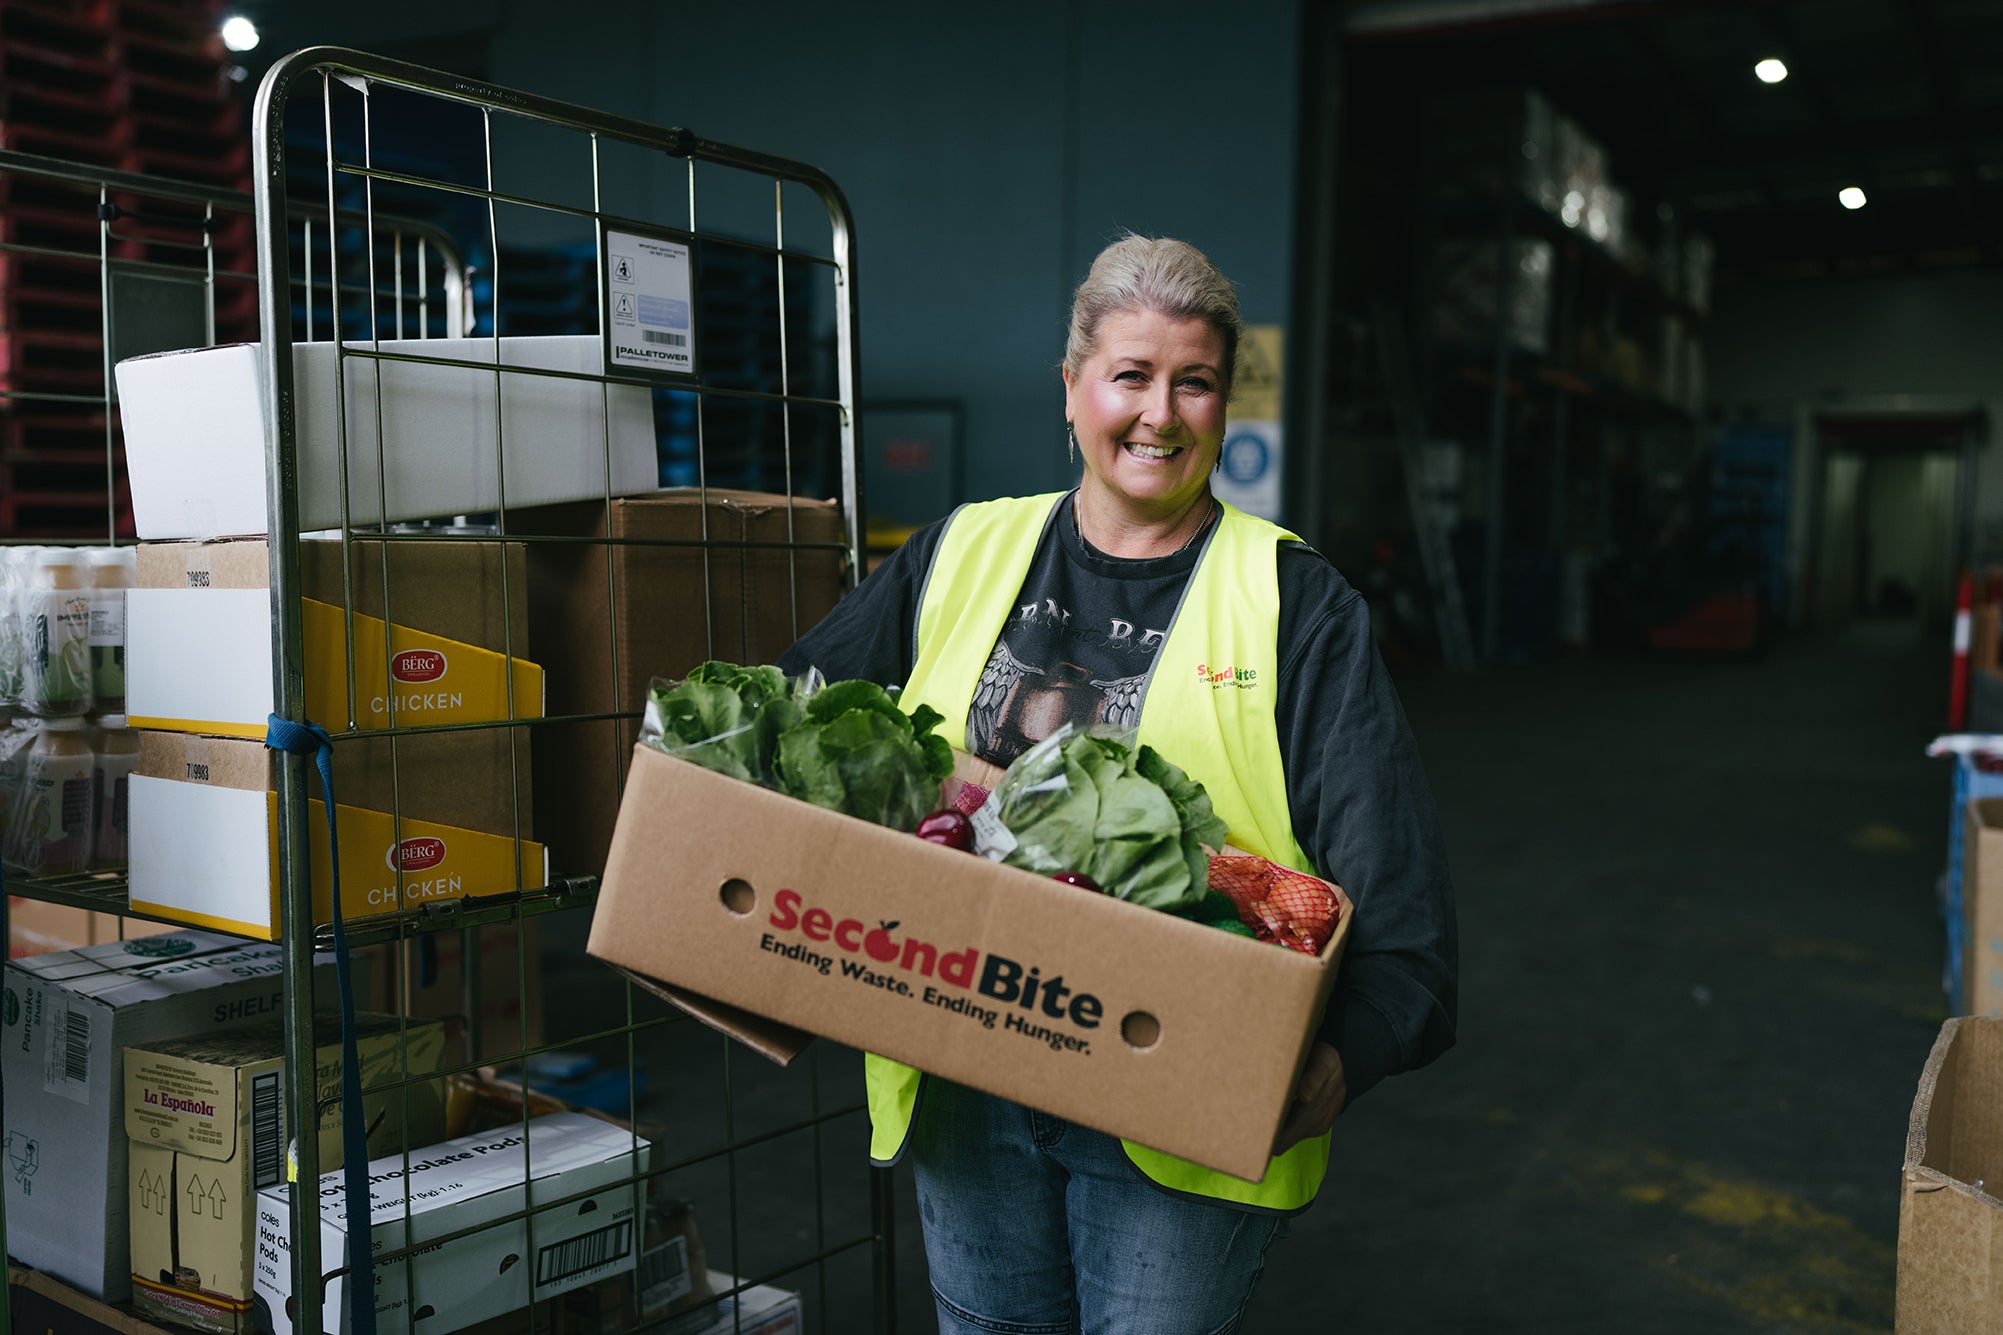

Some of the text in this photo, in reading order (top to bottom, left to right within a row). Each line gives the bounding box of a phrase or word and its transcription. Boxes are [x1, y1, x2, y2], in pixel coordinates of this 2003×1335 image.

[619, 346, 689, 362] PALLETOWER
[367, 873, 462, 905] CHCKEN
[135, 947, 282, 980] Pancake
[769, 888, 1104, 1030] SecondBite
[34, 990, 43, 1027] Shake
[760, 932, 1092, 1056] Ending Waste. Ending Hunger.
[21, 986, 34, 1054] Pancake
[143, 1087, 159, 1105] La
[160, 1091, 214, 1117] Española
[471, 1136, 526, 1155] Pods
[260, 1211, 280, 1229] coles
[260, 1225, 277, 1245] Hot
[259, 1242, 279, 1264] Pods
